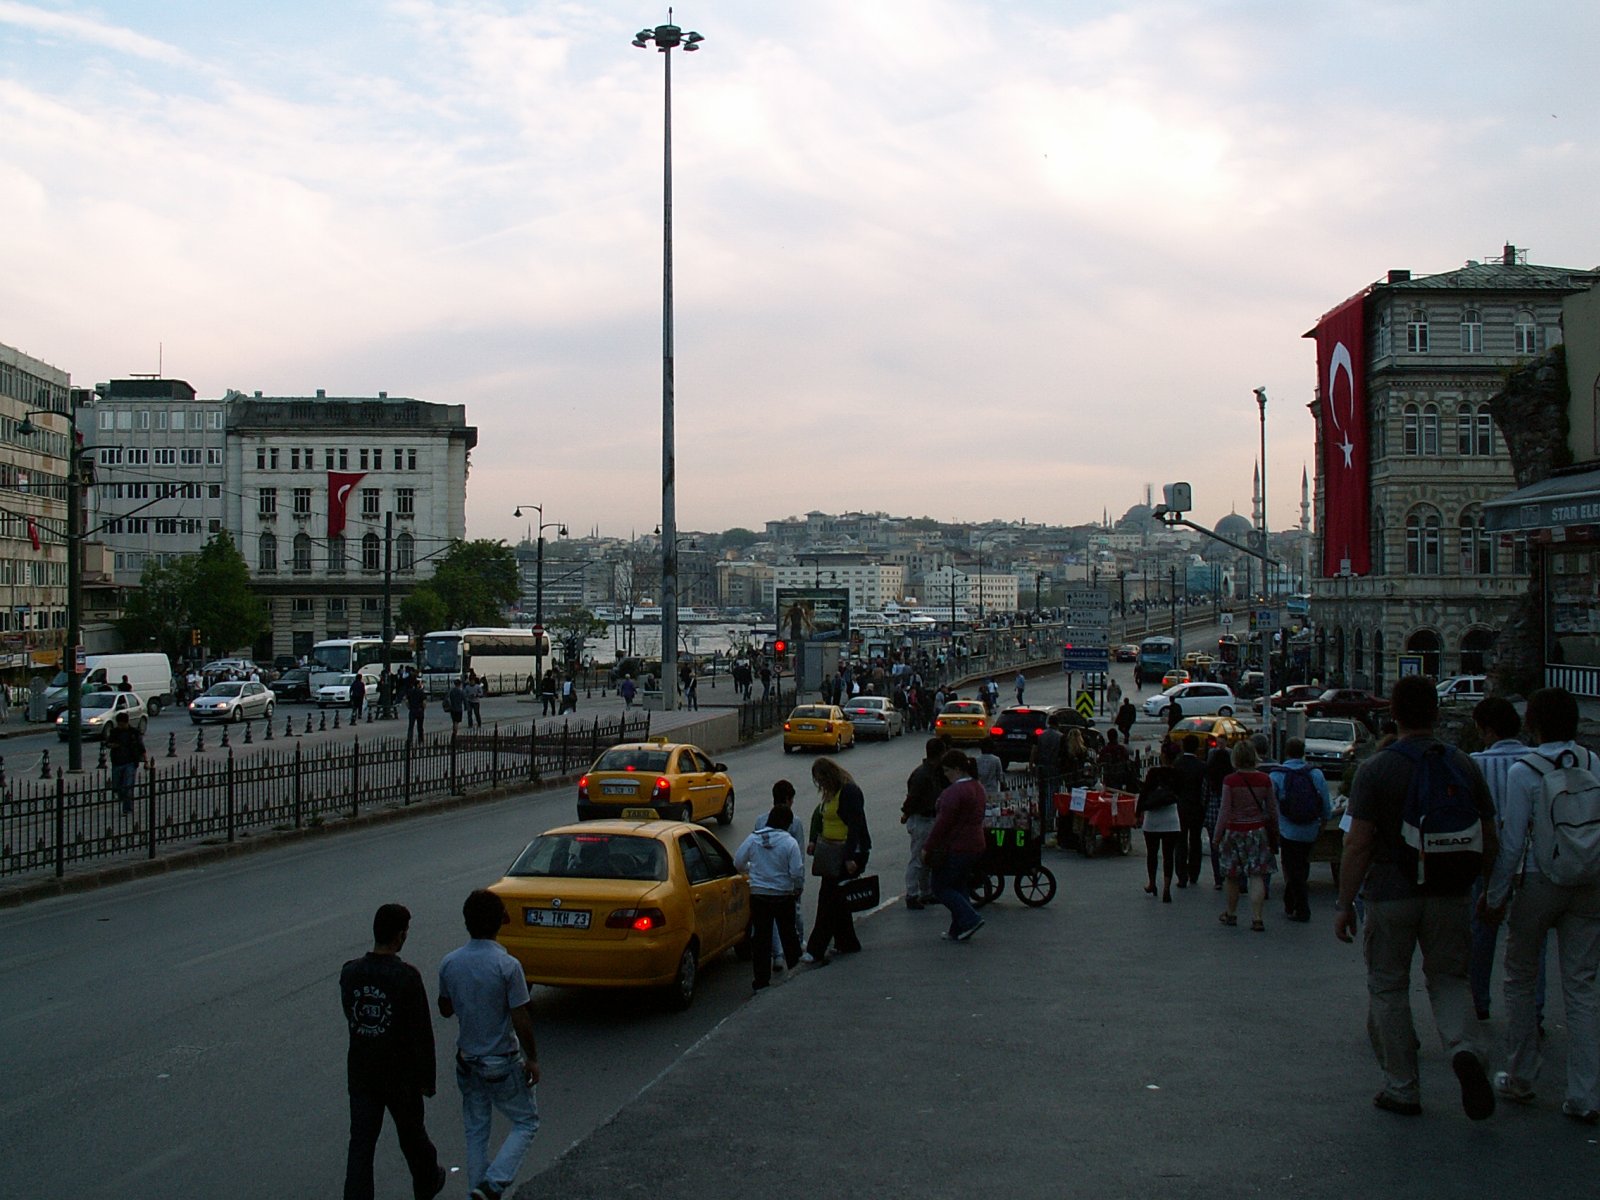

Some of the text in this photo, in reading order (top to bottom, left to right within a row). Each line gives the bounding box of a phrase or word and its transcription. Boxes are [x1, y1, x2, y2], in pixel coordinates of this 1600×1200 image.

[1551, 506, 1578, 521] STAR
[1580, 503, 1600, 519] ELE
[1427, 837, 1473, 847] HEAD
[846, 890, 873, 902] MANGO
[532, 910, 544, 922] 34
[574, 913, 587, 925] 23
